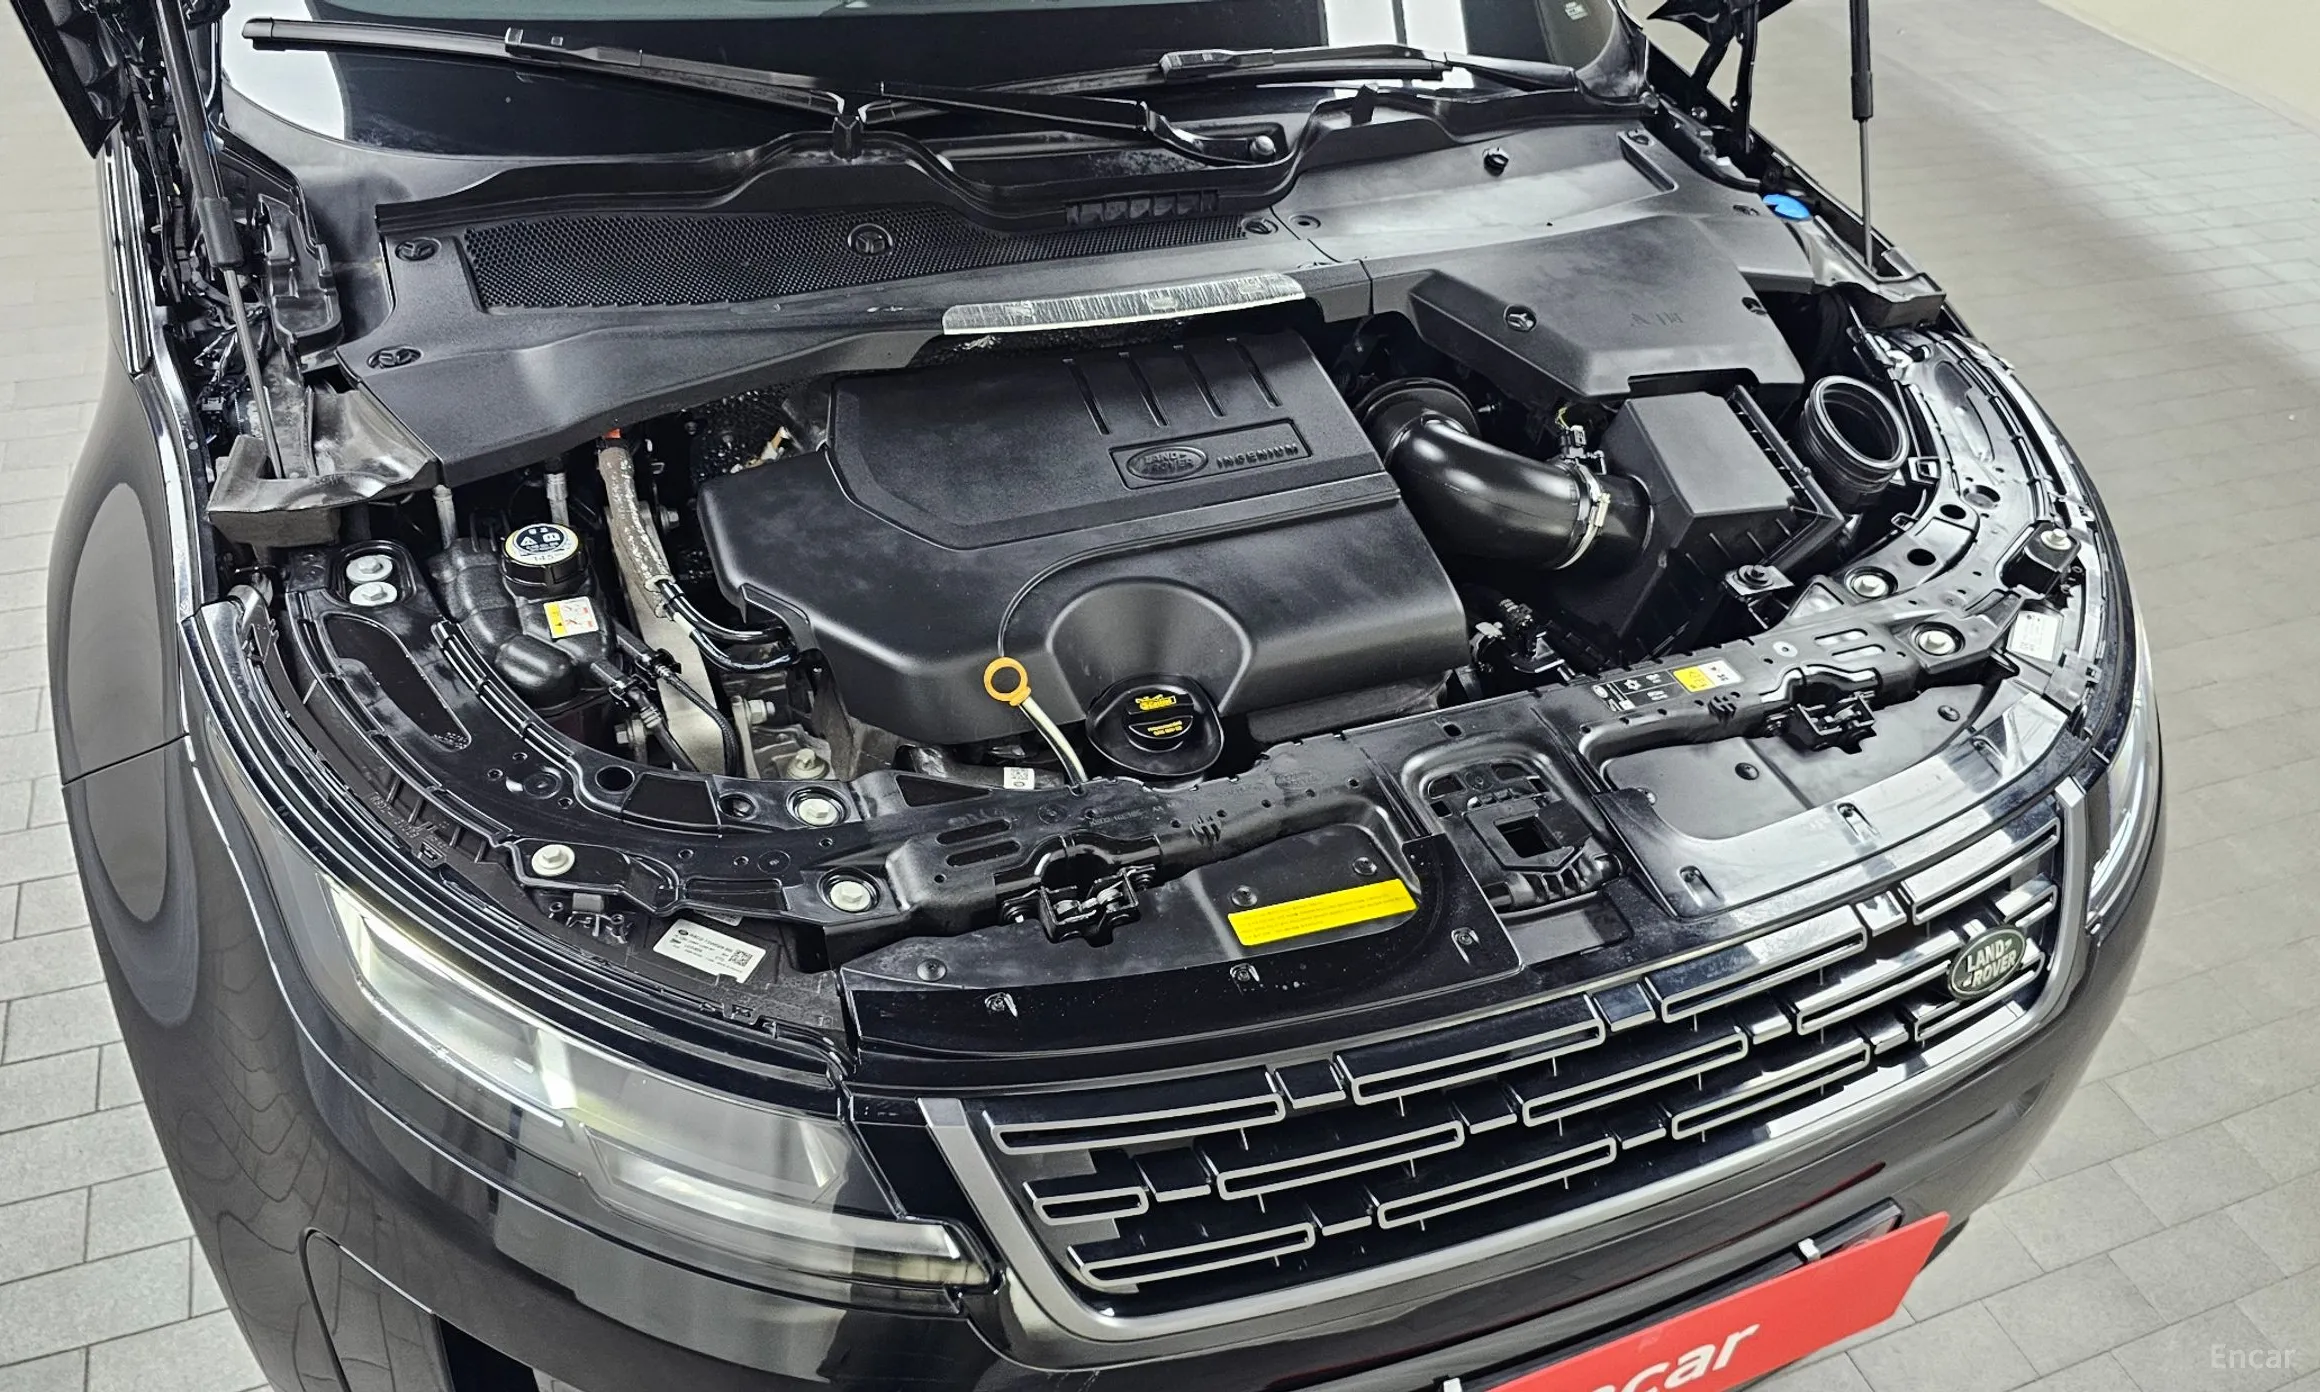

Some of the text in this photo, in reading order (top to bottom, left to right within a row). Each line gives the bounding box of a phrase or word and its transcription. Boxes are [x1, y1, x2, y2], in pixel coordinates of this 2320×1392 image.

[1216, 443, 1299, 469] INGENIUM
[1967, 938, 2005, 973] LAND
[1972, 950, 2017, 987] ROVER
